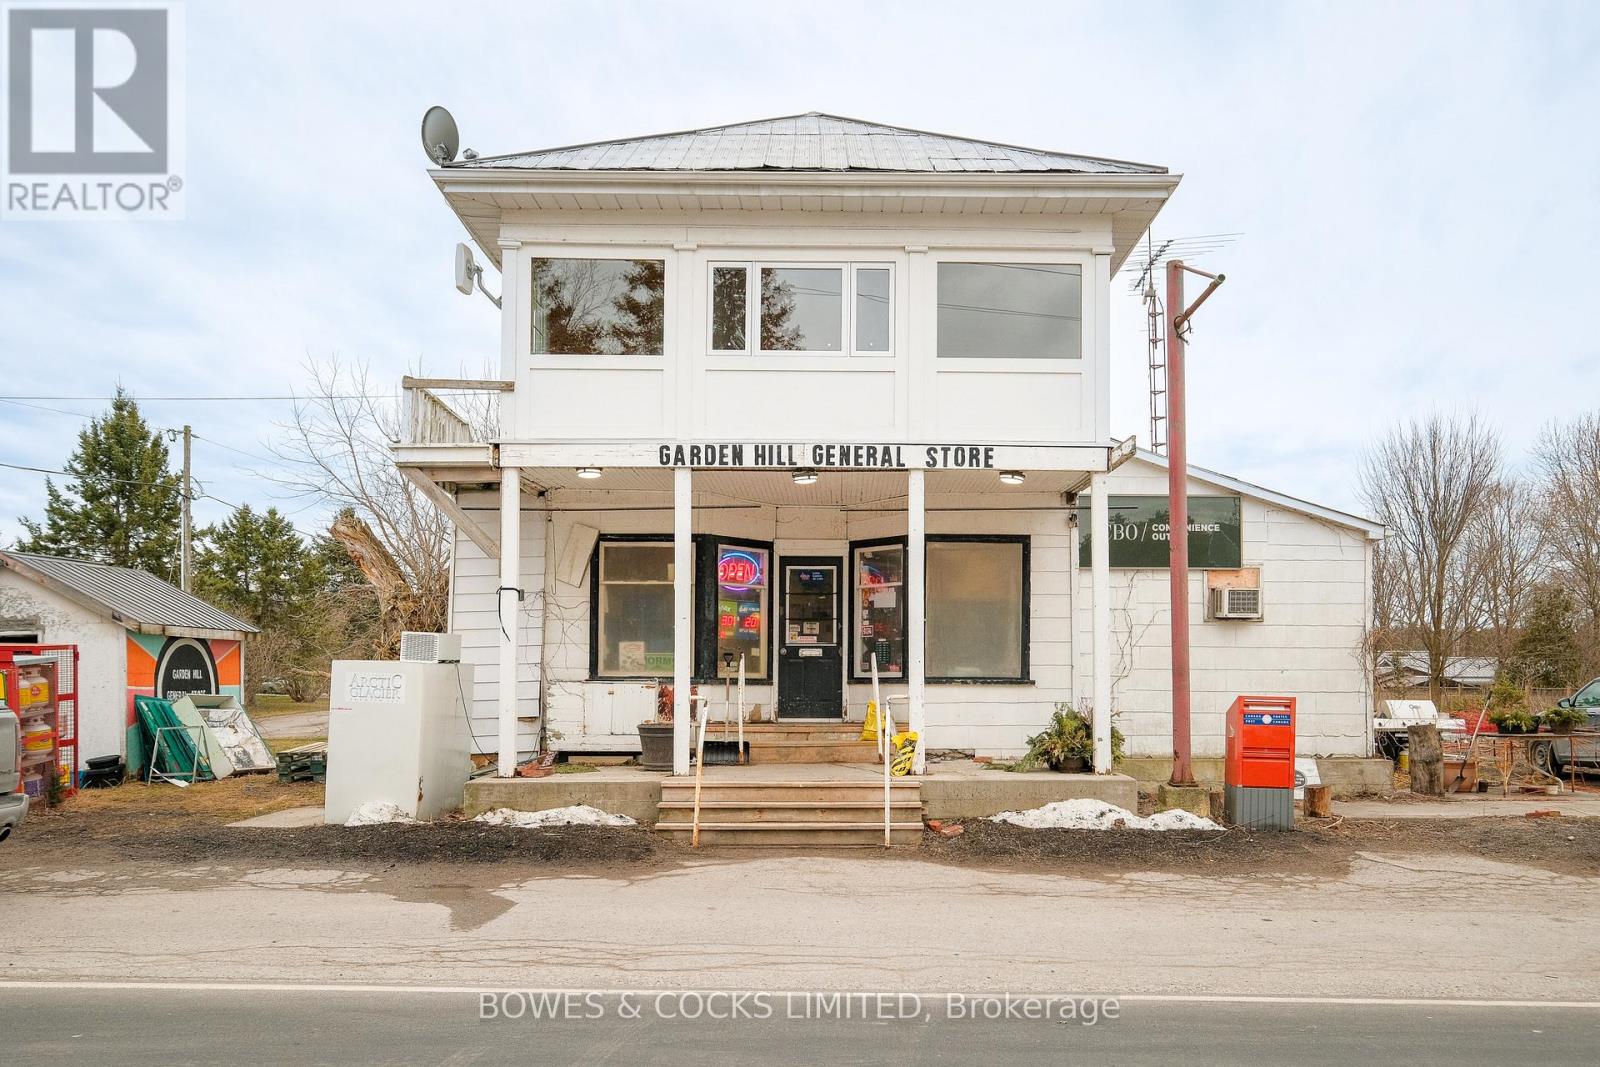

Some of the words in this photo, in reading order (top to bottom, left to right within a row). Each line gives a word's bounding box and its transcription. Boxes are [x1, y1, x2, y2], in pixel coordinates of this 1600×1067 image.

[659, 445, 743, 466] GARDEN
[754, 445, 797, 466] HILL
[812, 445, 906, 467] GENERAL
[926, 447, 995, 468] STORE
[1152, 524, 1220, 532] CONNIENCE
[719, 562, 755, 581] OPEN
[172, 669, 191, 680] GARDEN
[192, 669, 203, 679] HILL
[349, 673, 402, 689] ARCTIC
[350, 688, 400, 699] GLACIER
